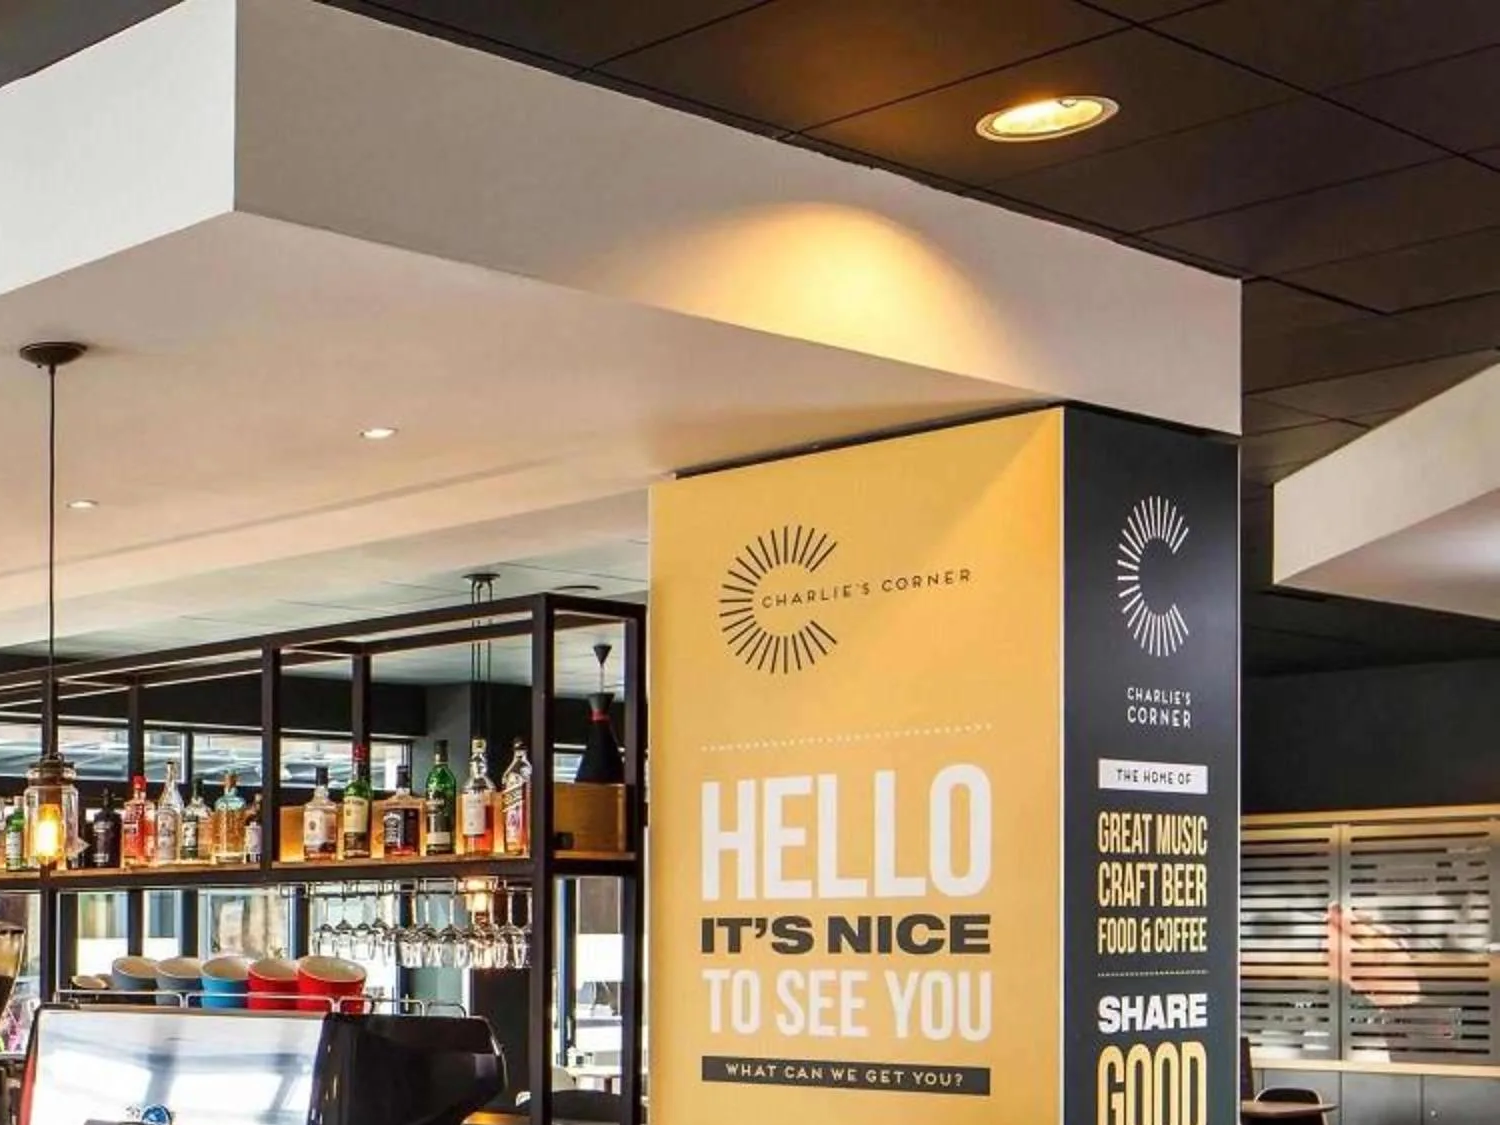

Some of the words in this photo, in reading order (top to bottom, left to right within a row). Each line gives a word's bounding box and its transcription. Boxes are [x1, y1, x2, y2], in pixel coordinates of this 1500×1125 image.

[761, 582, 871, 609] CHARLIE'S
[881, 568, 972, 594] CORNER
[1126, 687, 1192, 705] CHARLIE'S
[1126, 706, 1192, 729] CORNER
[1116, 768, 1139, 783] THE
[1143, 770, 1174, 785] HOME
[1177, 773, 1192, 785] OF
[701, 763, 992, 901] HELLO
[1098, 810, 1152, 855] GREAT
[1156, 813, 1209, 856] MUSIC
[1098, 861, 1158, 908] CRAFT
[1161, 863, 1208, 908] BEER
[701, 915, 815, 955] IT'S
[827, 913, 991, 955] NICE
[1098, 916, 1138, 955] FOOD
[1141, 917, 1151, 954] &
[1154, 916, 1208, 953] COFFEE
[702, 968, 761, 1035] TO
[775, 968, 870, 1037] SEE
[883, 969, 992, 1042] YOU
[1097, 992, 1208, 1034] SHARE
[725, 1063, 776, 1078] WHAT
[784, 1065, 823, 1080] CAN
[830, 1067, 857, 1082] WE
[865, 1069, 904, 1084] GET
[913, 1071, 964, 1087] YOU?
